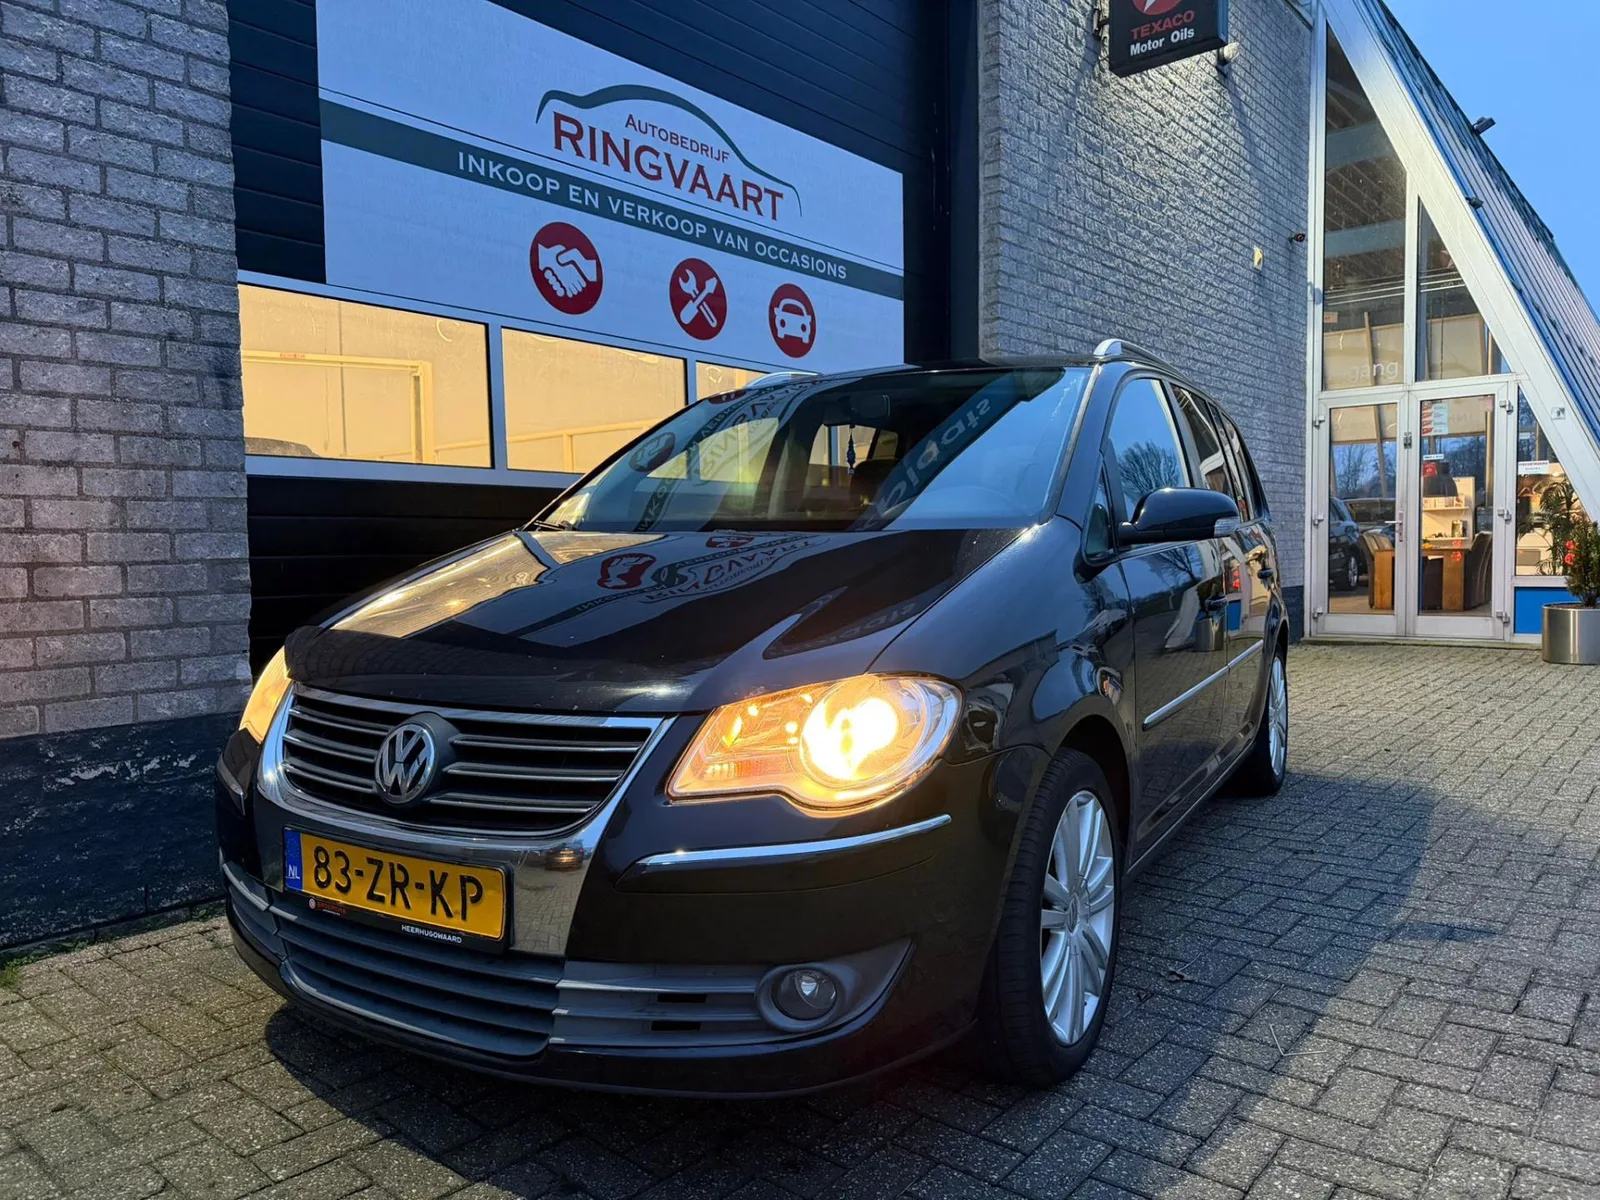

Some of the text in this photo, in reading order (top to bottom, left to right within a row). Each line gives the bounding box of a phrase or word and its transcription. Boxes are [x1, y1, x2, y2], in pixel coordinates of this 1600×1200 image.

[1130, 10, 1195, 40] TEXACO
[1130, 27, 1195, 56] Motor Oils
[624, 113, 731, 164] AUTOBEDRIJF
[552, 110, 784, 221] RINGVAART
[458, 151, 848, 281] INKOOP EN VERKOOP VAN OCCASIONS
[287, 864, 301, 881] NL
[312, 844, 484, 922] 83-ZR-KP
[400, 923, 463, 945] HEERHUGOWAARD
